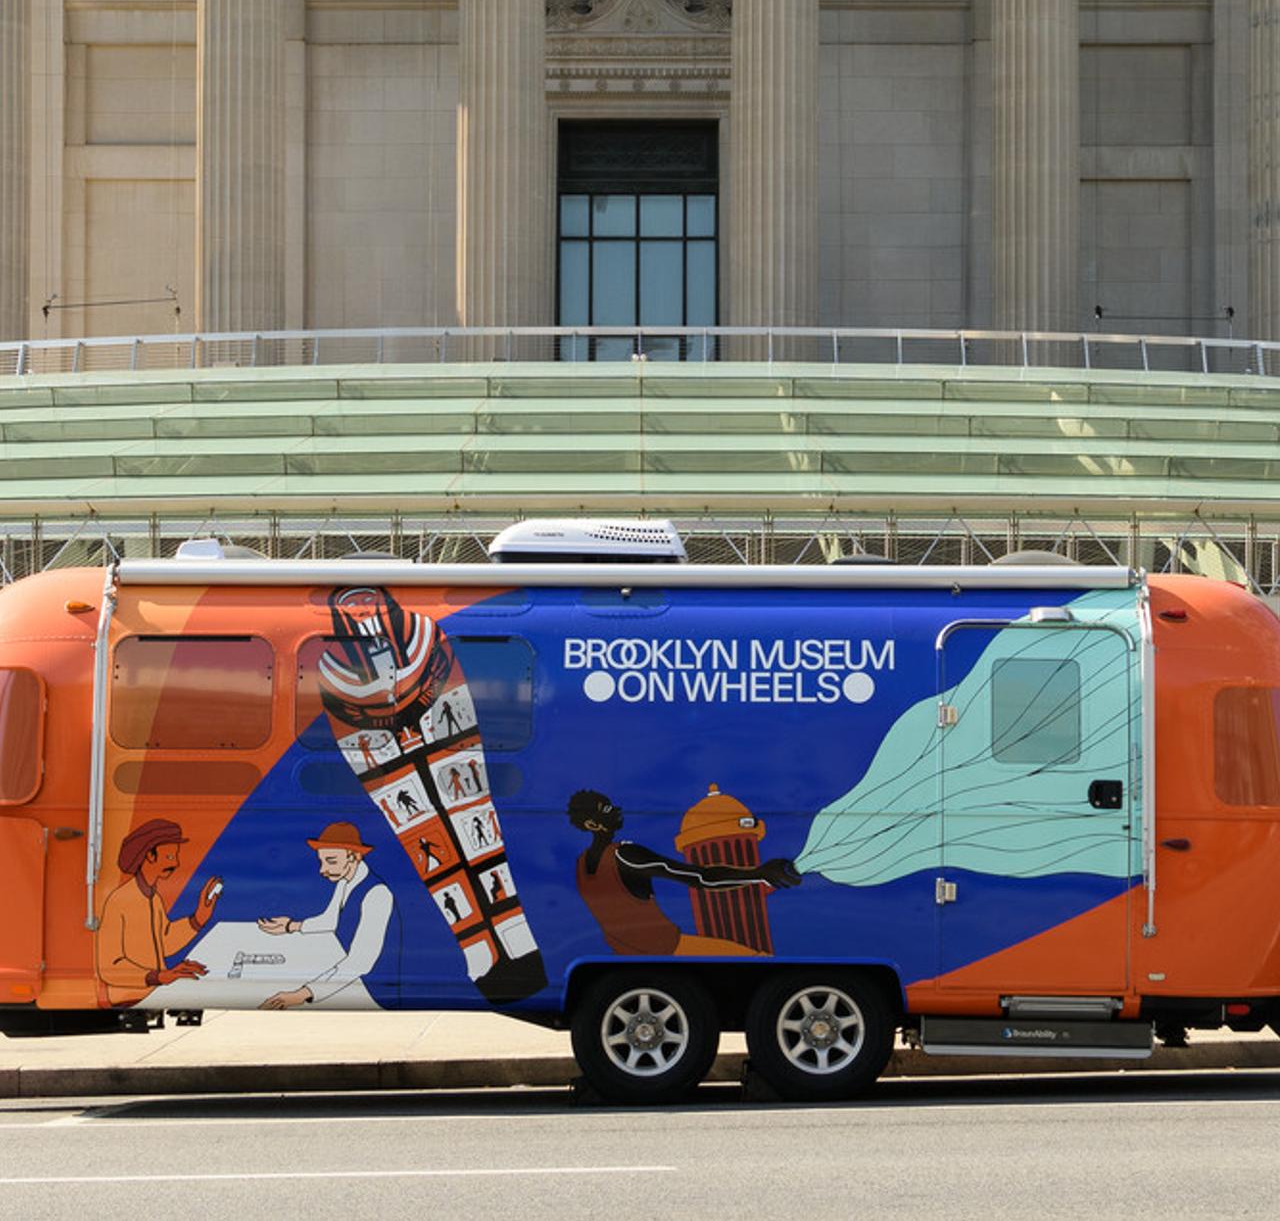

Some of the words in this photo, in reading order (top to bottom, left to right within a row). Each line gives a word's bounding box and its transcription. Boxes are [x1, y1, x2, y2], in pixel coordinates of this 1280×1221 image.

[564, 639, 738, 670] BROOKLYN
[750, 639, 895, 671] MUSEUM
[618, 671, 675, 703] ON
[681, 671, 842, 704] WHEELS
